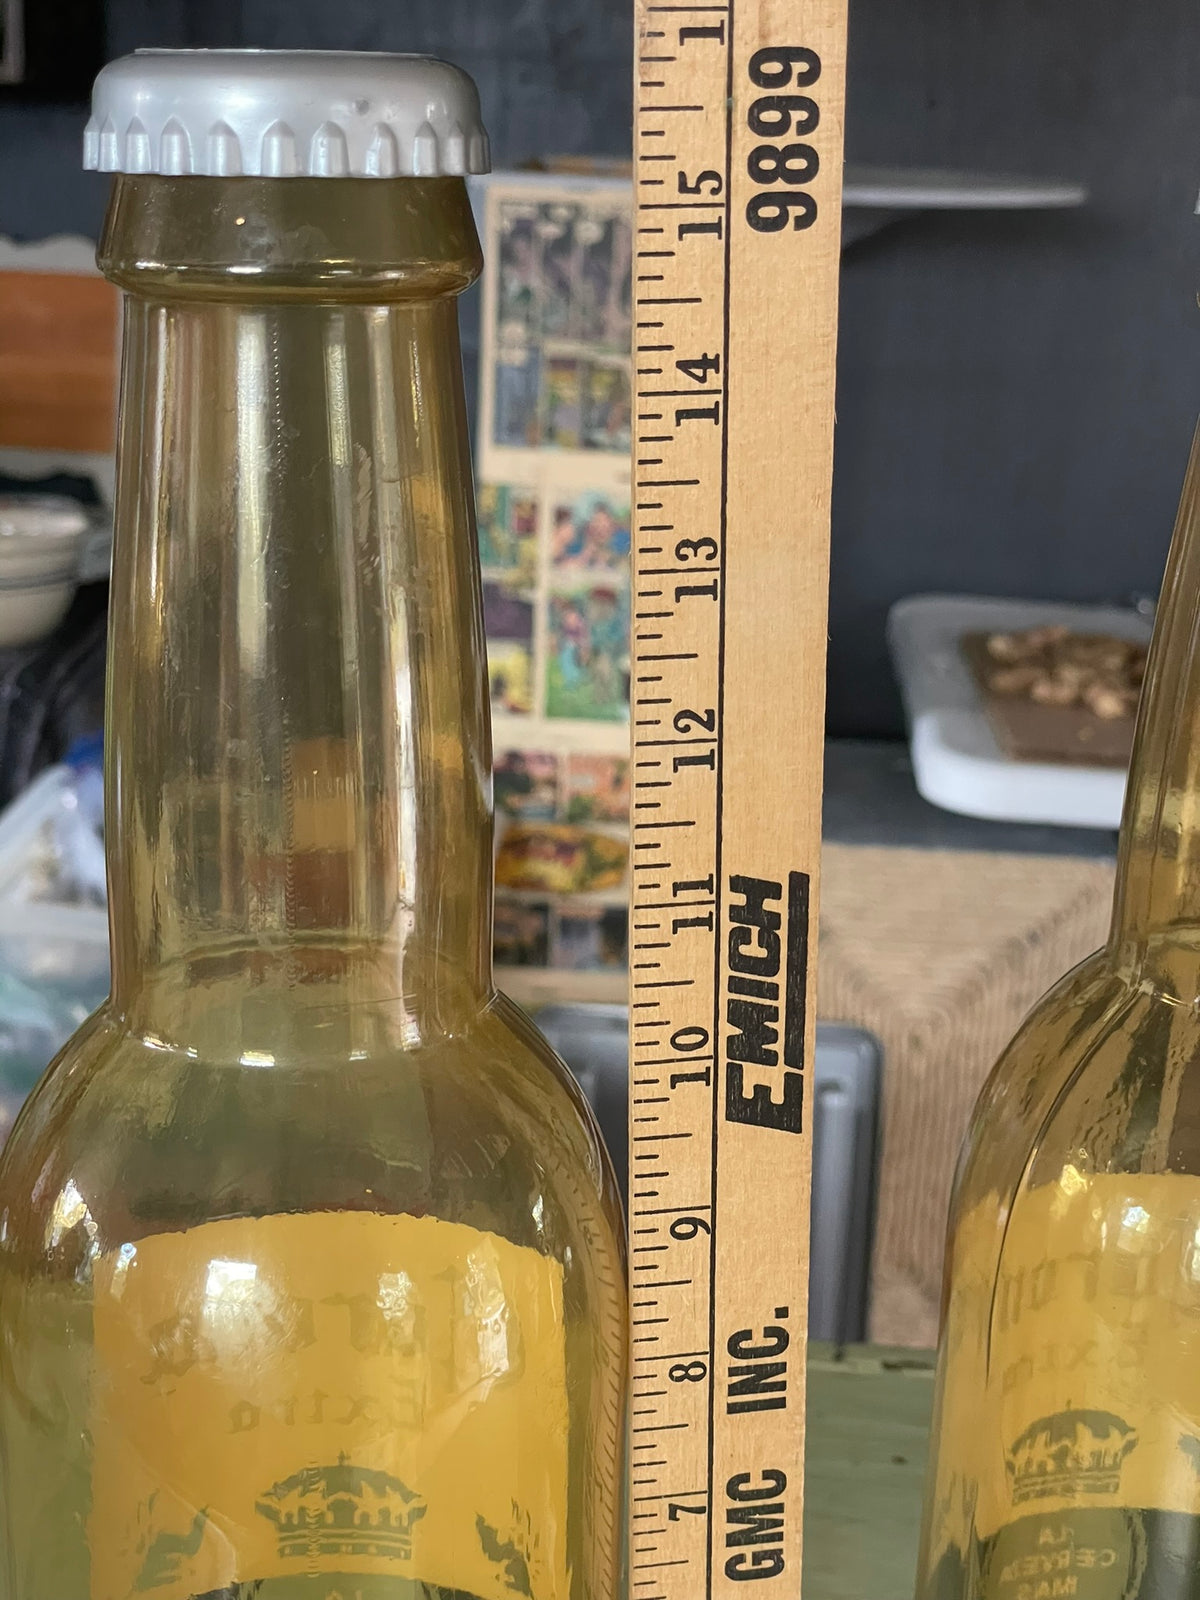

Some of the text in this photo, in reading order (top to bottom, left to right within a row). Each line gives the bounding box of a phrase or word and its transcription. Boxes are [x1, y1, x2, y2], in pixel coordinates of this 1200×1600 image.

[746, 46, 821, 233] 9899
[678, 170, 723, 241] 15
[675, 353, 720, 426] 14
[675, 537, 718, 602] 13
[673, 709, 715, 773] 12
[672, 873, 713, 934] 11
[725, 873, 804, 1134] EMICH
[670, 1026, 711, 1089] 10
[669, 1216, 711, 1240] 9
[668, 1361, 707, 1383] 8
[725, 1306, 789, 1581] GMC INC.
[668, 1503, 707, 1521] 7
